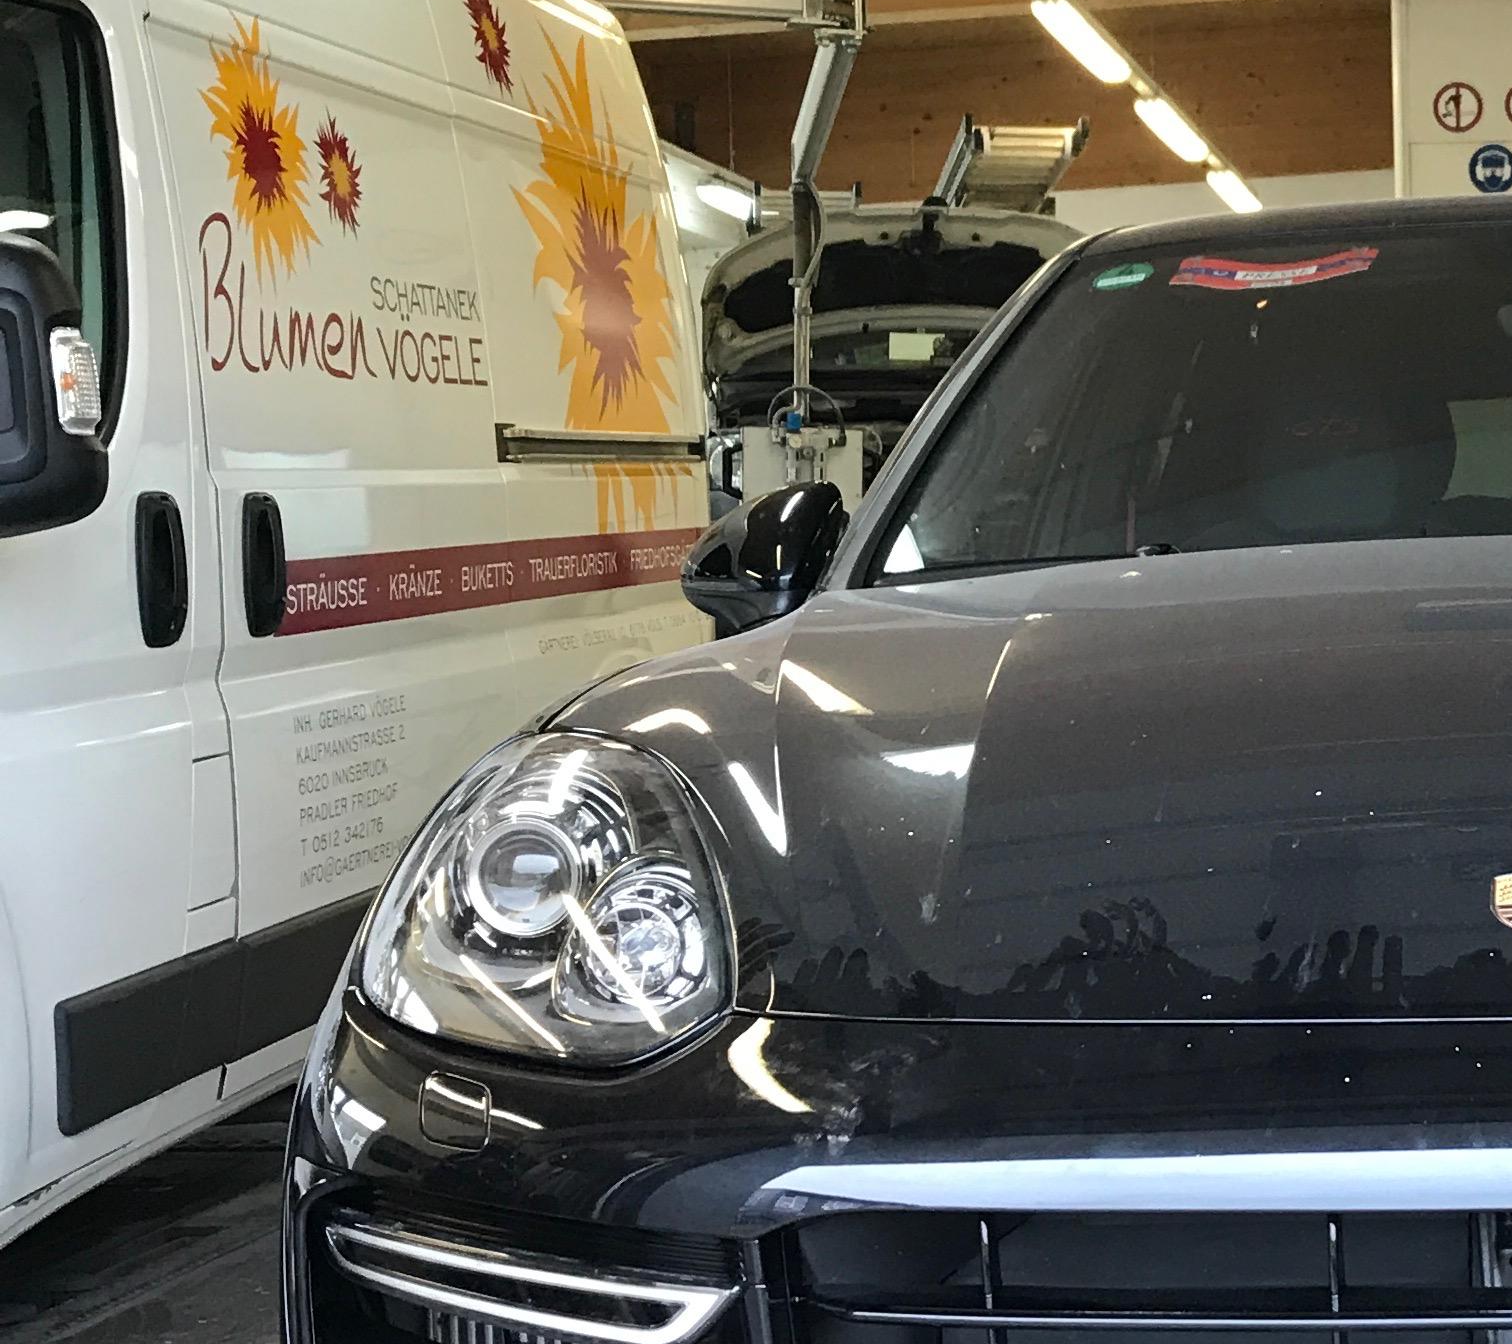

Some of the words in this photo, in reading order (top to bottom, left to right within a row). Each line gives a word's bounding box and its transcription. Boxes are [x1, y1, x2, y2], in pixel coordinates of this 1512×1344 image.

[199, 212, 378, 380] Blumen
[376, 312, 488, 386] VÖGELE
[370, 275, 481, 322] SCHATTANEK
[286, 573, 368, 614] STRÄUSSE
[389, 564, 442, 601] KRÄNZE
[461, 561, 515, 592] BUKETTS
[529, 551, 618, 583] TRAUERFLORISTIK
[319, 703, 366, 730] GERHARD
[369, 694, 407, 718] VÖGELE
[296, 725, 396, 765] KAUFMANNSTRASSE
[398, 723, 406, 741] 2
[298, 772, 330, 796] 6020
[332, 757, 388, 785] INNSBRUCK
[300, 797, 348, 827] PRADLER
[351, 782, 398, 813] FRIEDHOF
[300, 838, 309, 857] T
[312, 829, 341, 854] 0512
[343, 816, 384, 844] 342176
